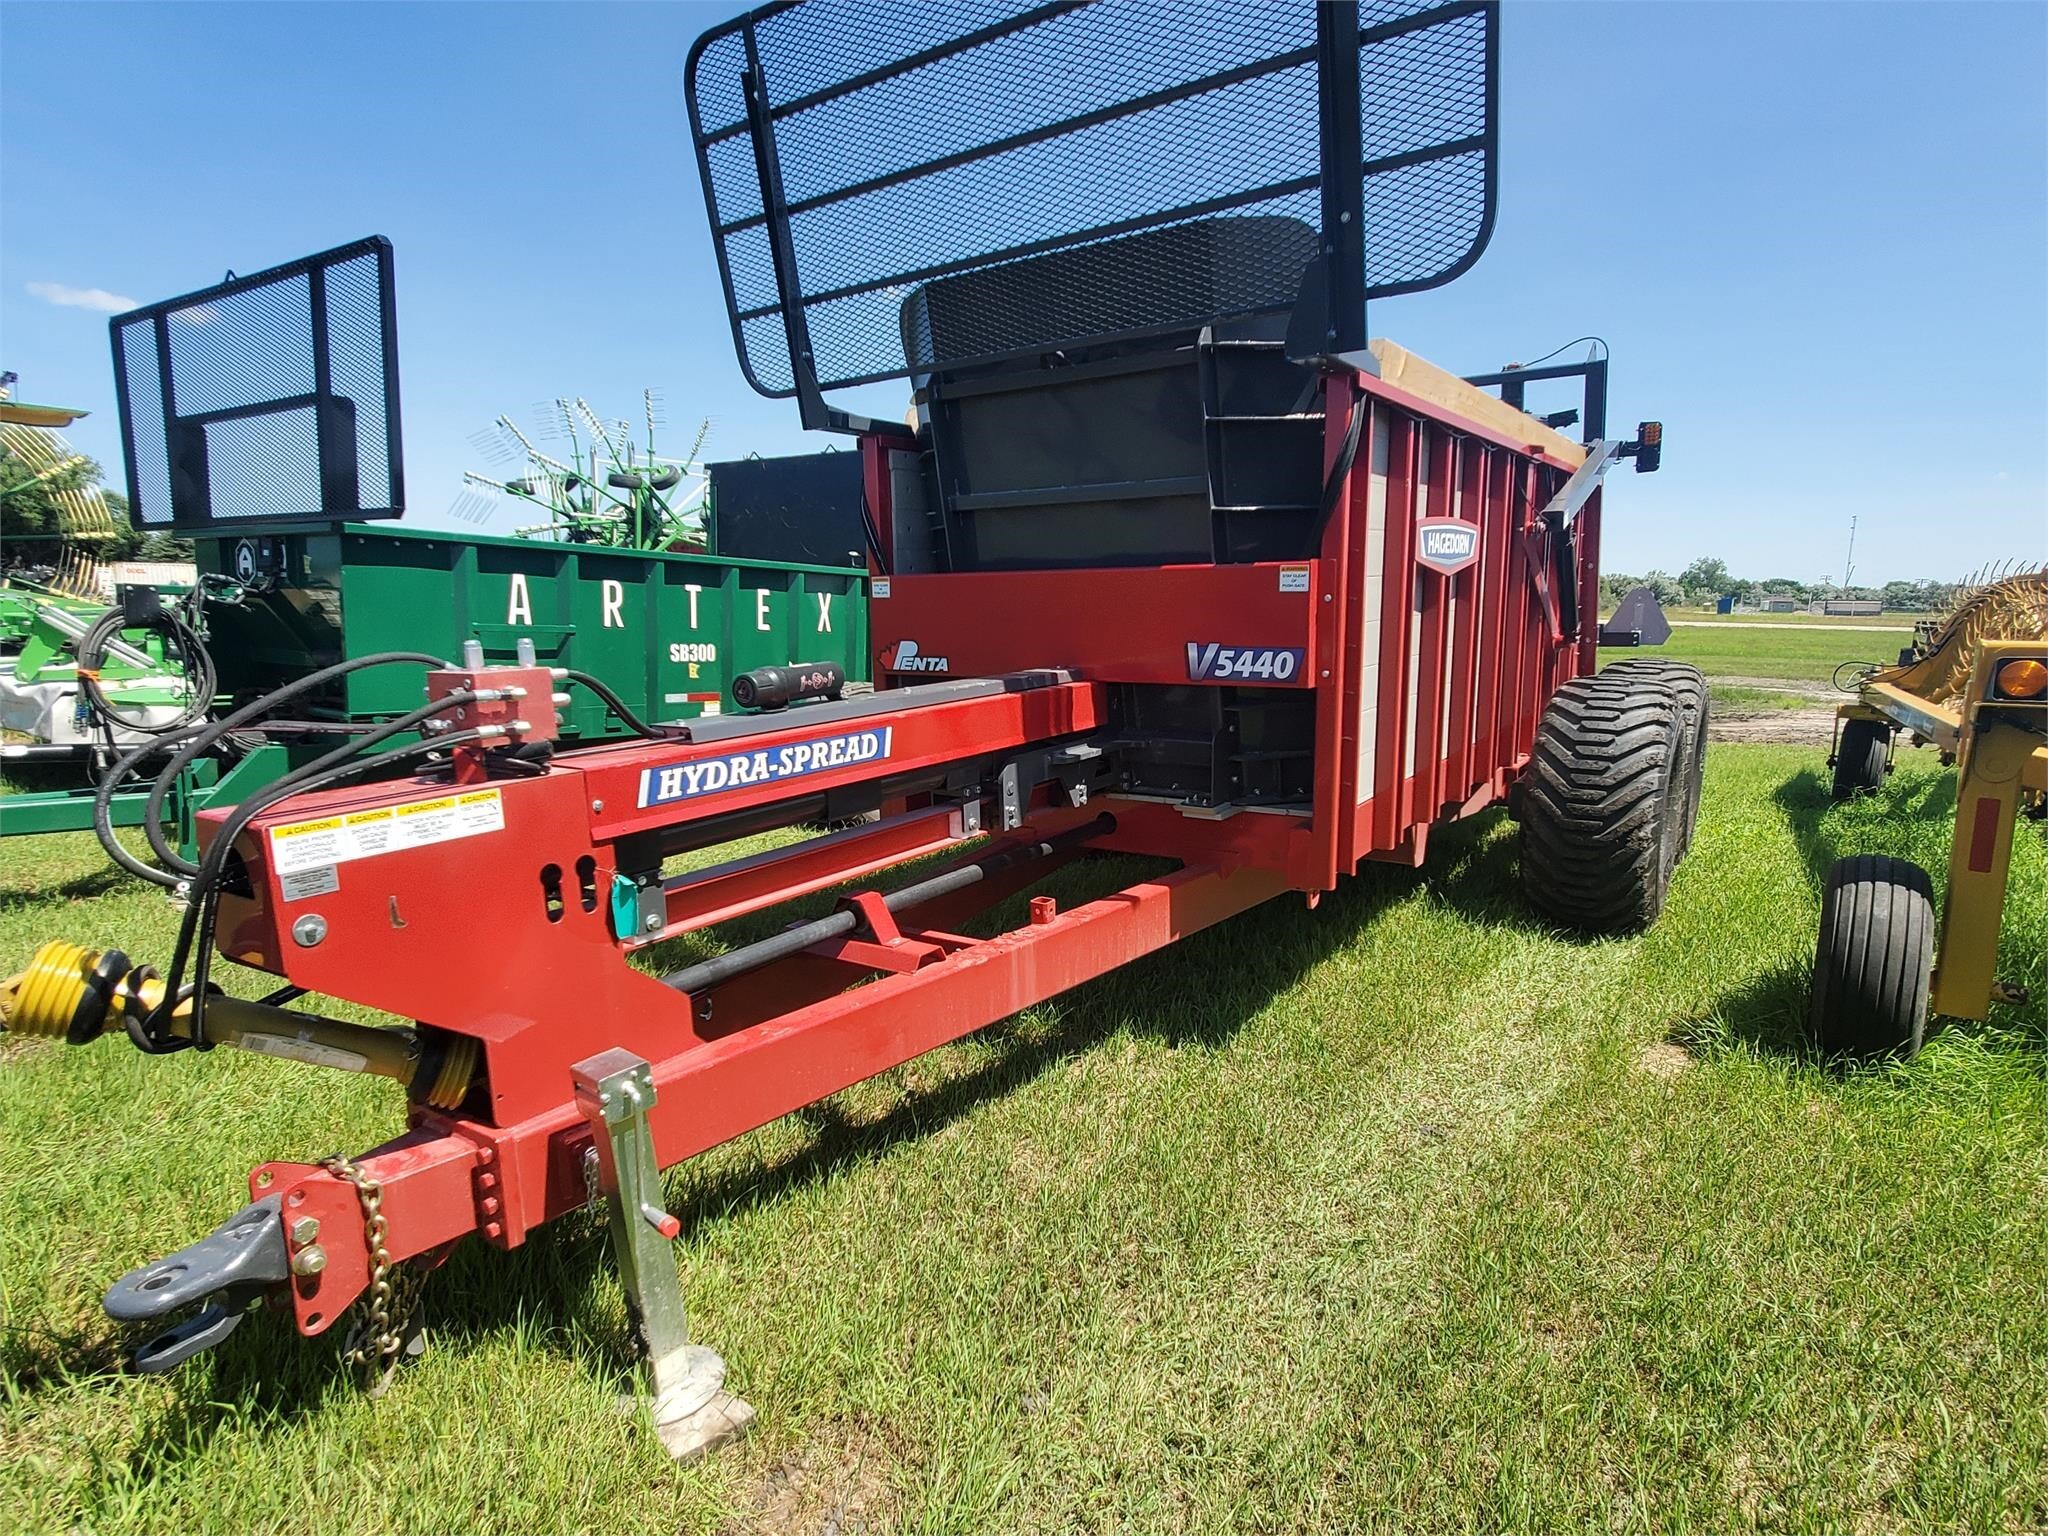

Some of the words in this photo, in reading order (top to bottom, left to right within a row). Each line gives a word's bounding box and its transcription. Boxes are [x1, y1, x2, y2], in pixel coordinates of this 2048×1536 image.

[1427, 531, 1470, 555] HAGEDORN
[669, 643, 716, 662] SB300
[893, 640, 949, 671] PENTA
[1187, 642, 1295, 680] V5440
[656, 732, 880, 801] HYDRA-SPREAD
[357, 811, 392, 822] CAUTION
[411, 801, 447, 812] CAUTION
[293, 821, 332, 834] CAUTION
